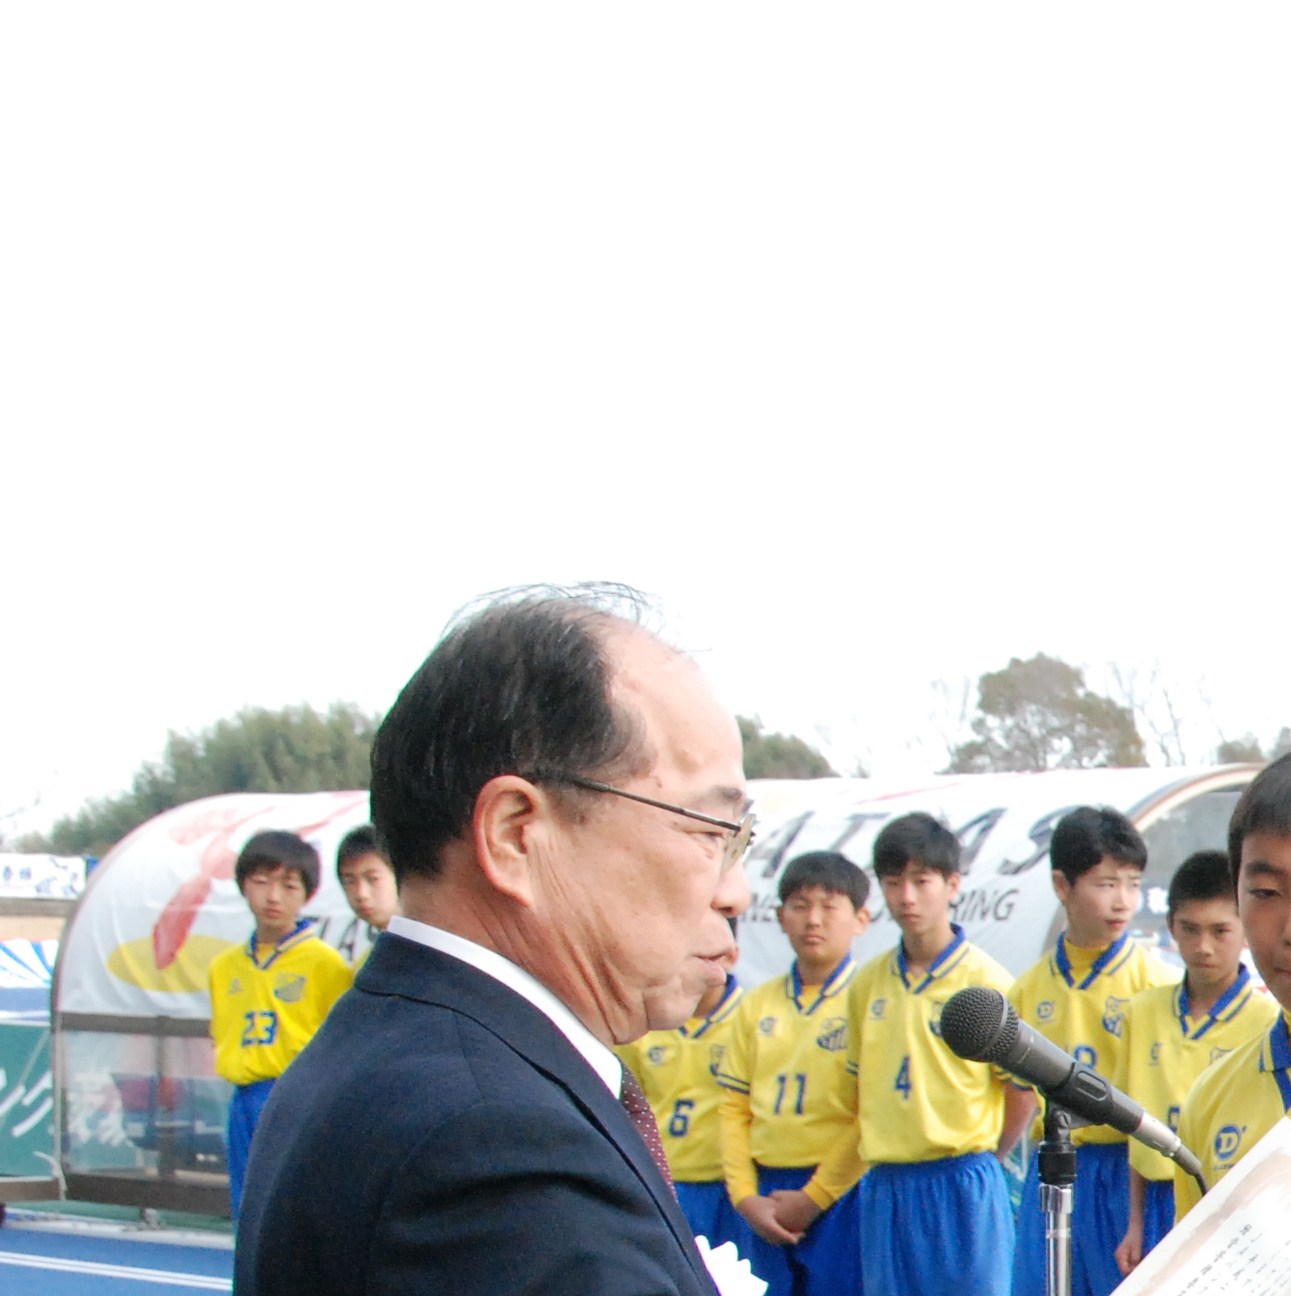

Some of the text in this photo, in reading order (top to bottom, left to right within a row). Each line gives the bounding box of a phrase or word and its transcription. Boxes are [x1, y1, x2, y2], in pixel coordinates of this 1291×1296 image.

[242, 1011, 278, 1047] 23
[773, 1073, 807, 1116] 11
[893, 1055, 911, 1099] 4
[668, 1100, 695, 1137] 6
